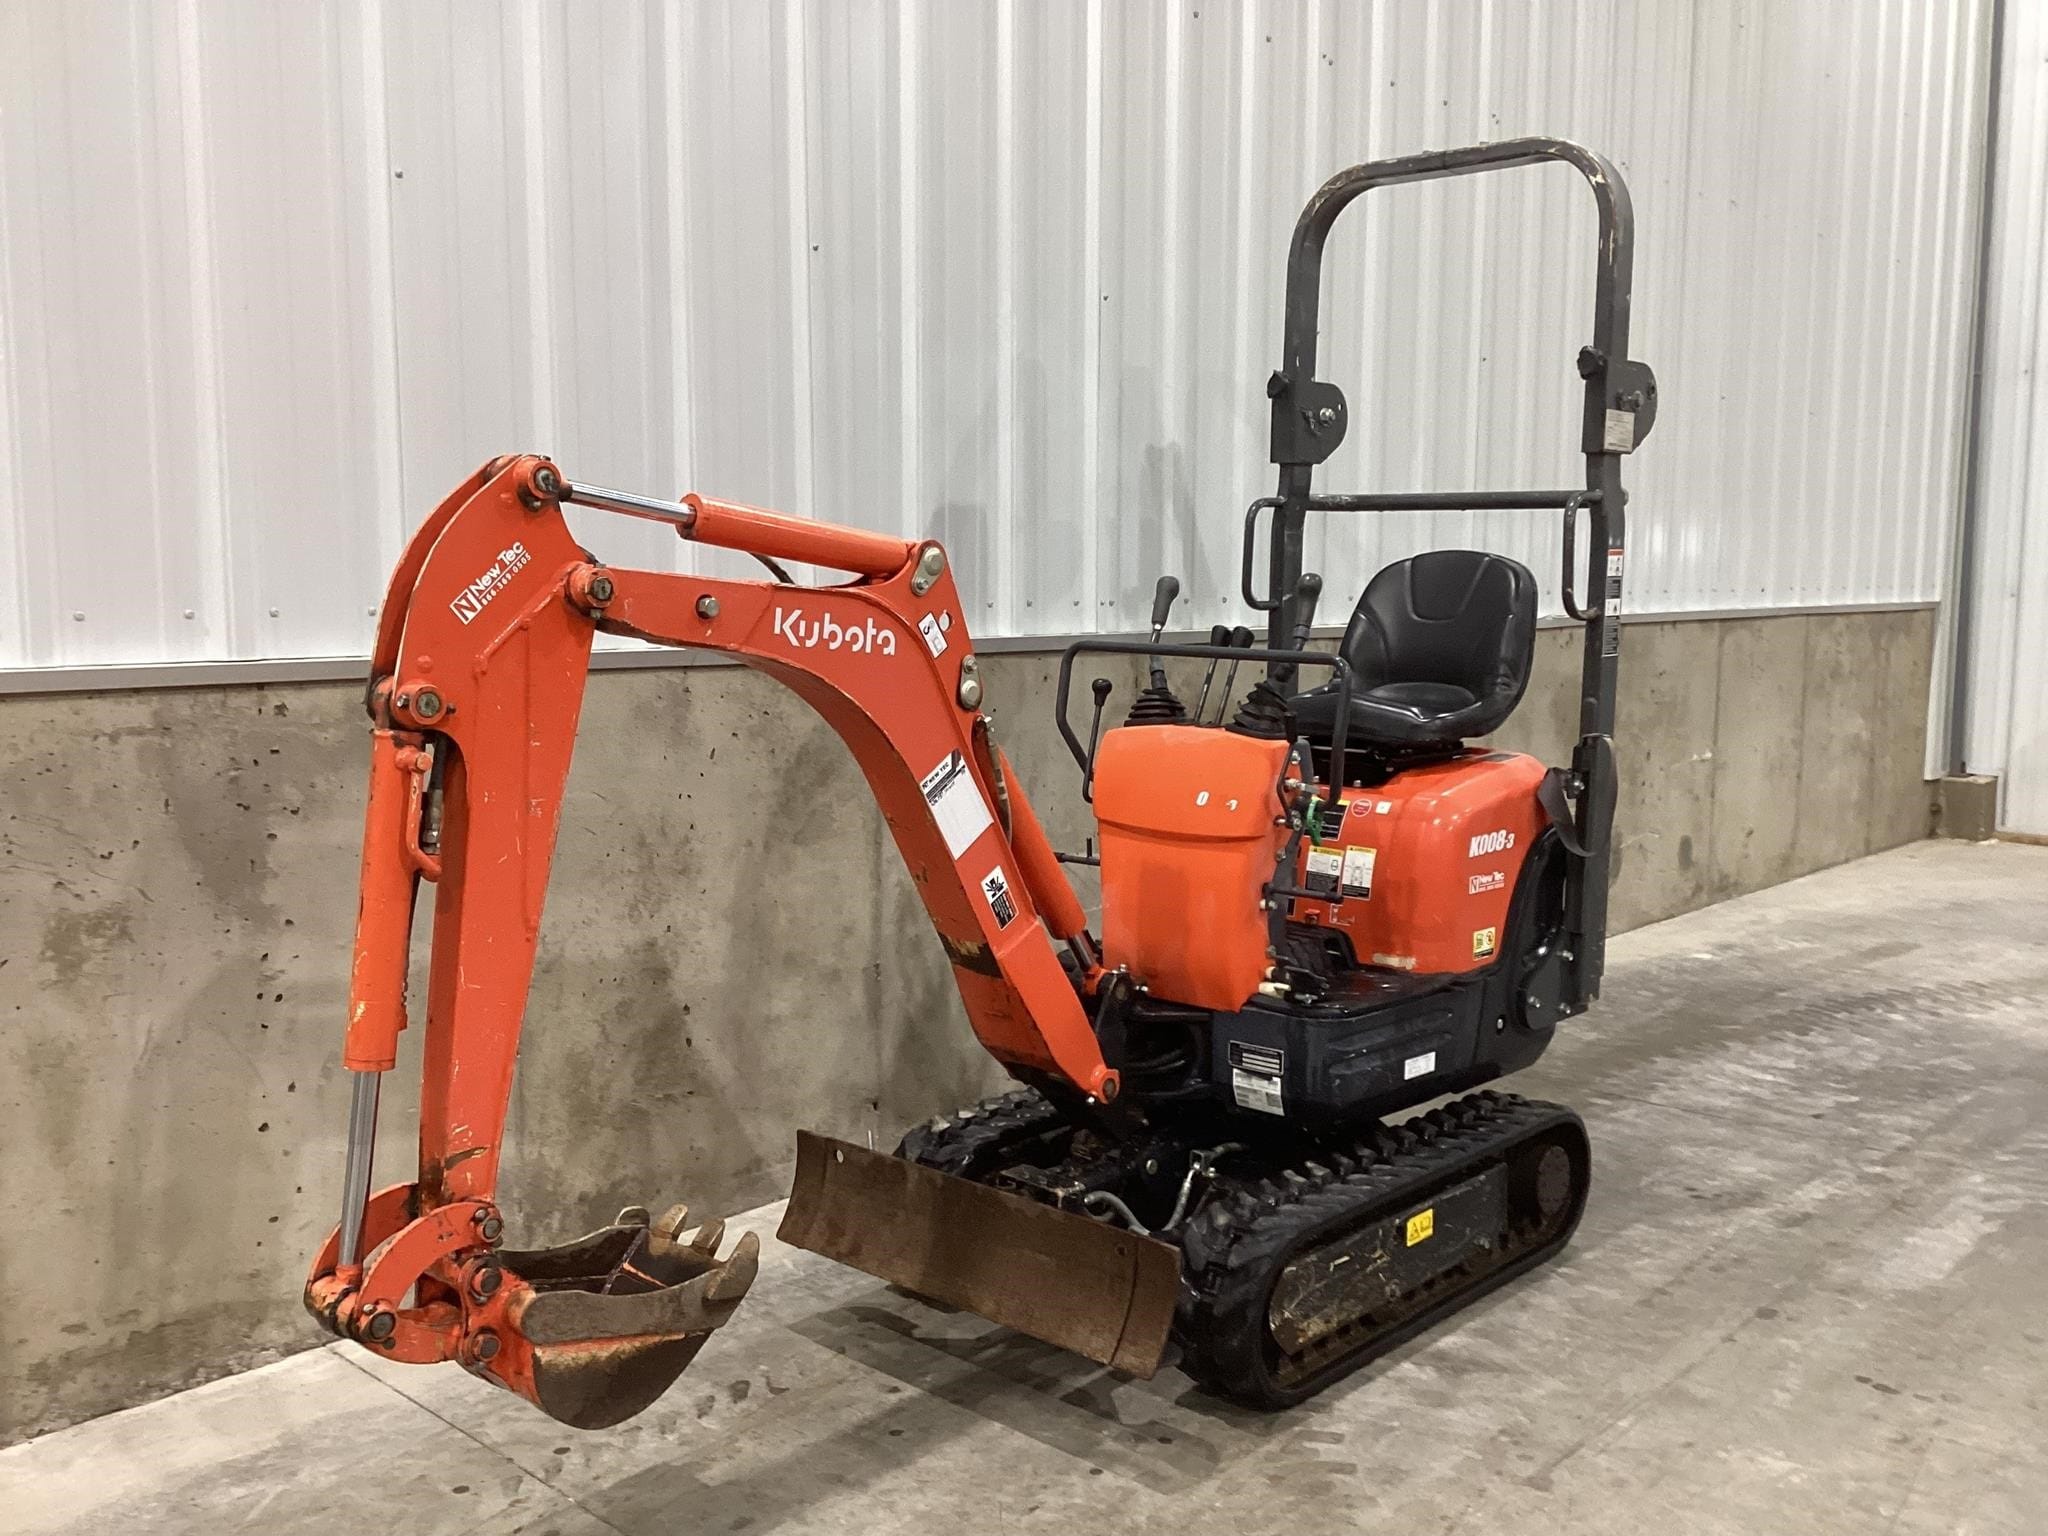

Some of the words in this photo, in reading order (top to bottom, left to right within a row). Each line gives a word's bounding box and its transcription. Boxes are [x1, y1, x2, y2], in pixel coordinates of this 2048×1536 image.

[469, 563, 501, 596] New
[497, 541, 524, 565] Tec
[773, 607, 896, 656] Kubota
[1469, 829, 1515, 858] K008-3
